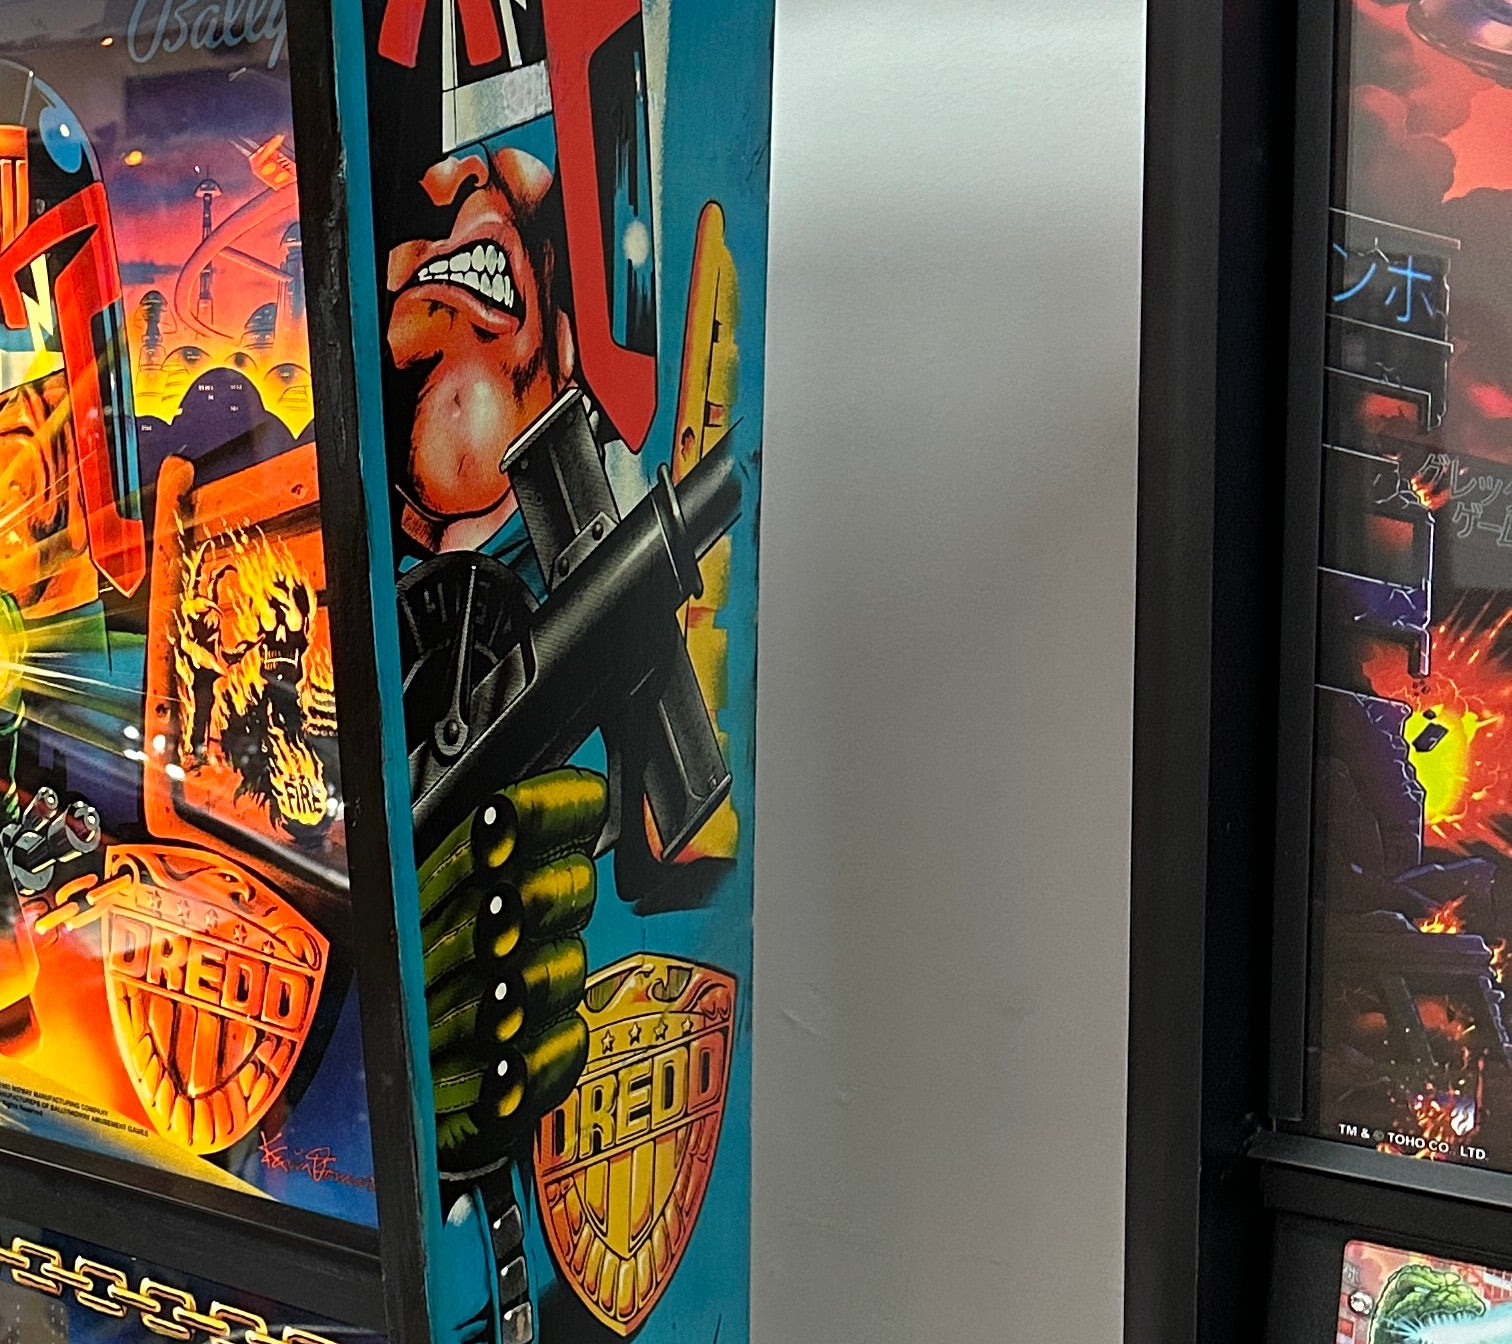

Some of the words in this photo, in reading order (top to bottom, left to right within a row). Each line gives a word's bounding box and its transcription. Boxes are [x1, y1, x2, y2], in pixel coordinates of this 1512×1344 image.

[284, 780, 324, 815] FIRE
[109, 915, 311, 1030] DREDD
[540, 1040, 724, 1174] DREDD
[1339, 1124, 1357, 1137] TM
[1360, 1127, 1370, 1139] &
[1387, 1132, 1426, 1150] TOHO
[1460, 1144, 1489, 1161] LTD.
